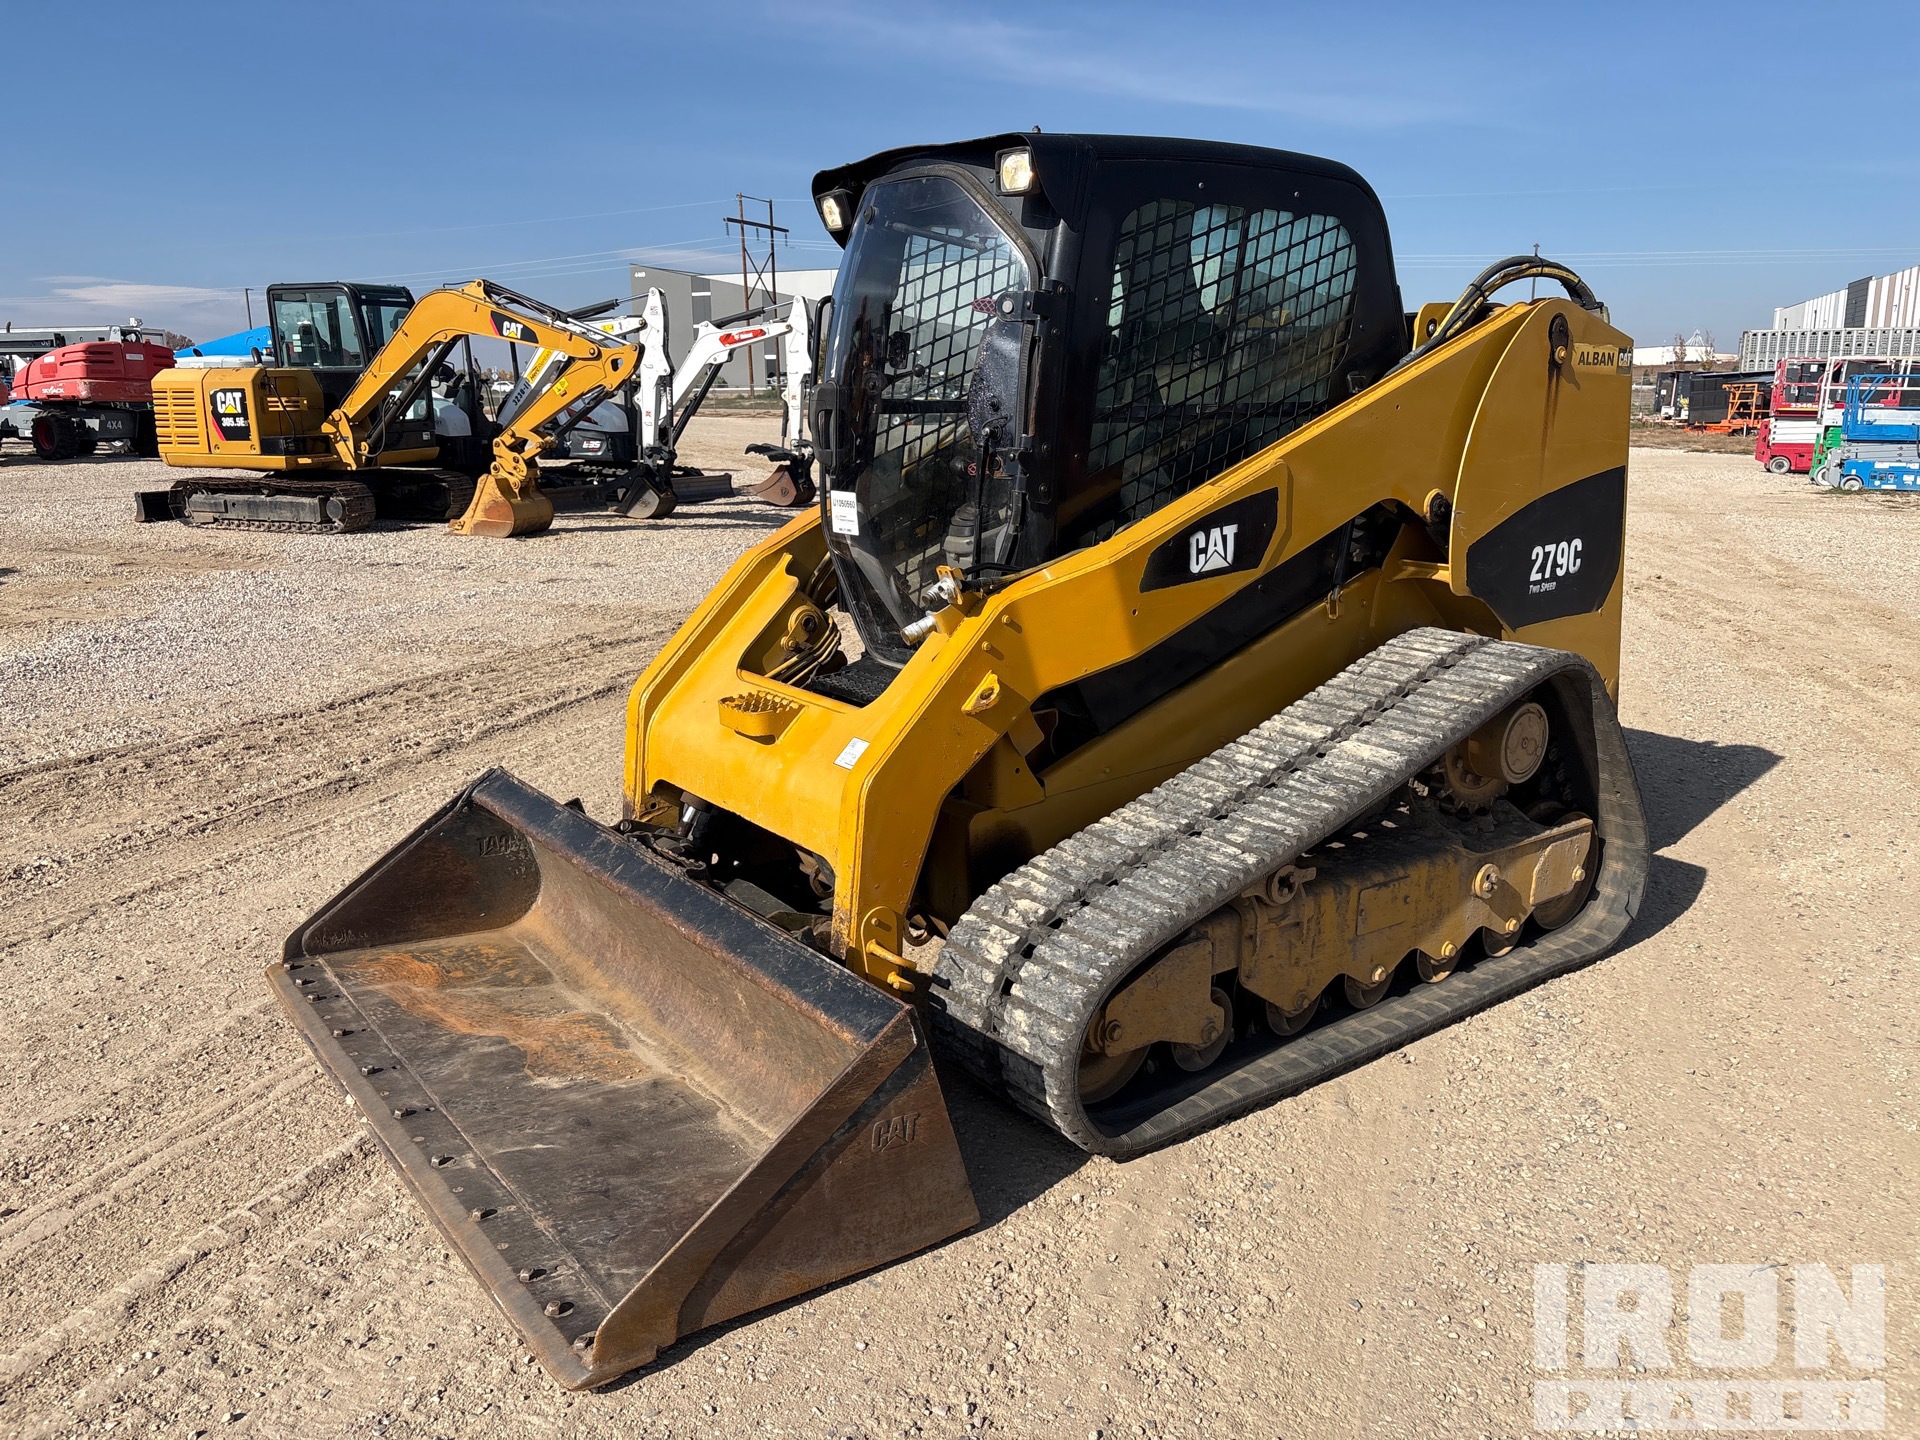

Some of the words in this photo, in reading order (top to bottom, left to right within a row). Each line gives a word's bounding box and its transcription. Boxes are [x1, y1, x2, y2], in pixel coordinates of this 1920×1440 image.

[502, 321, 524, 339] CAT
[1578, 351, 1615, 367] ALBAN
[216, 391, 242, 414] CAT
[106, 420, 123, 430] 4X4
[832, 498, 856, 509] U1050560
[1189, 523, 1239, 574] CAT
[1529, 538, 1583, 582] 279C
[871, 1111, 921, 1154] CAT
